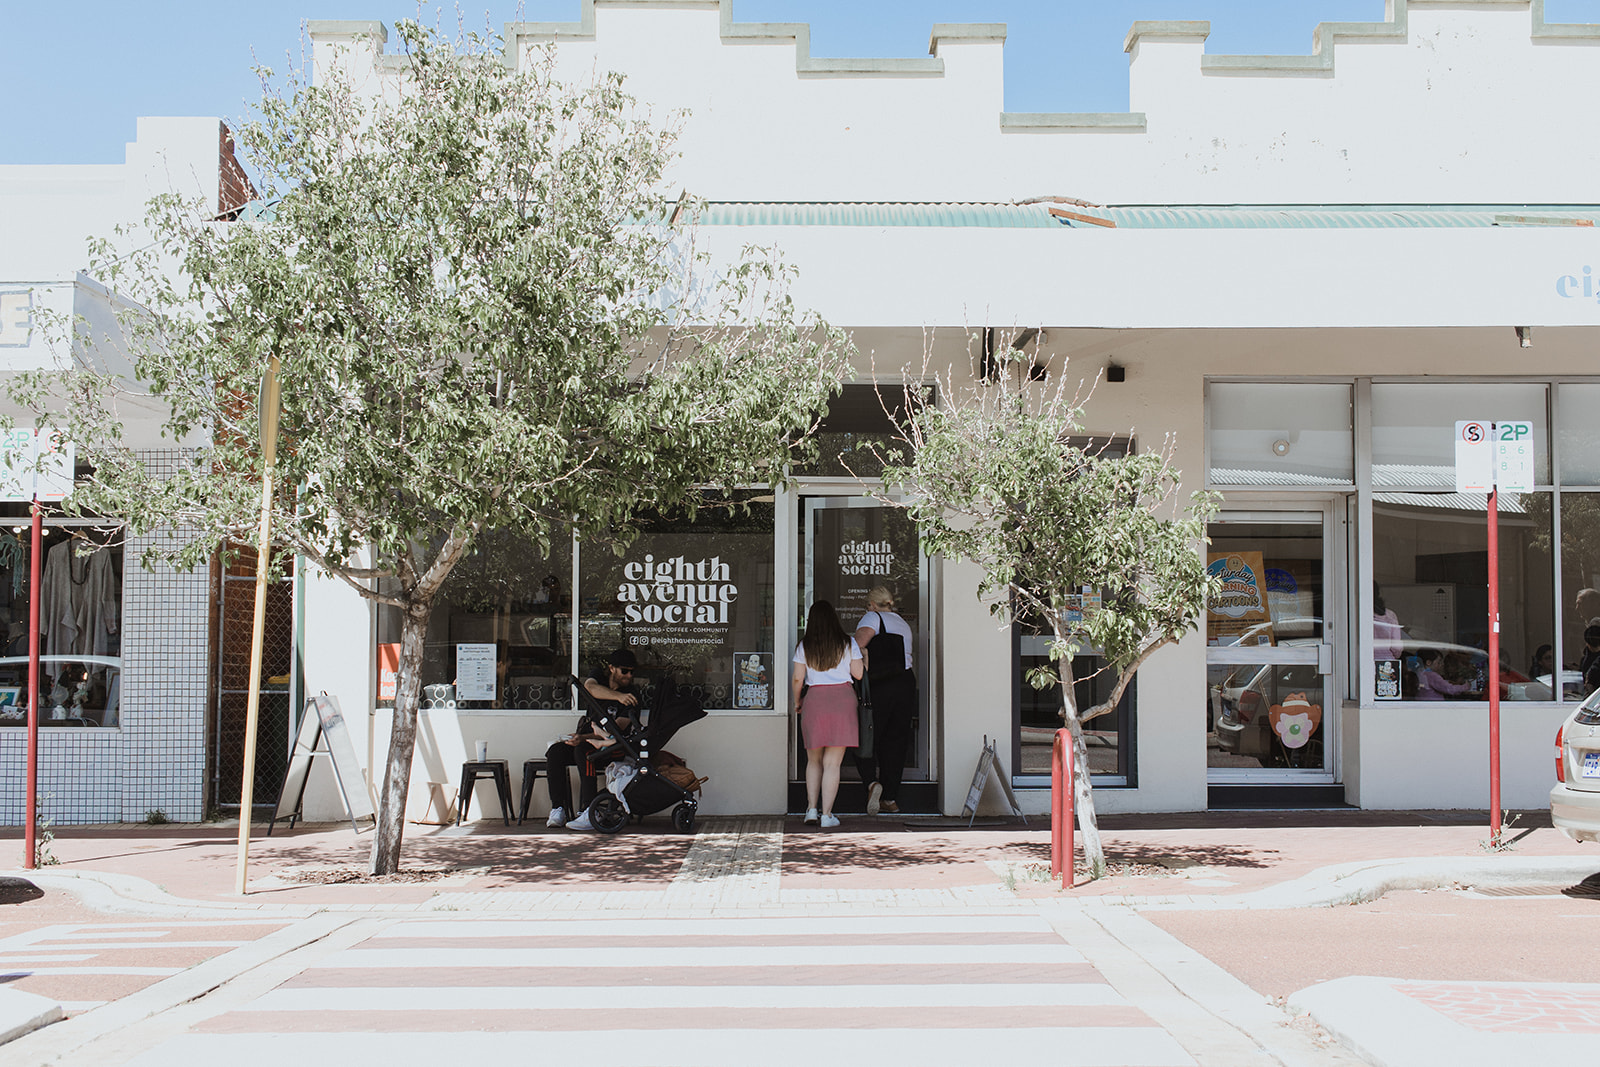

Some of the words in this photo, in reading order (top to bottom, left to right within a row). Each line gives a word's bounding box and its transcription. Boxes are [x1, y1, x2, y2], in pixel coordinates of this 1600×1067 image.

[1556, 265, 1600, 304] ei
[2, 431, 30, 448] 2P
[1501, 424, 1529, 441] 2P
[840, 540, 891, 556] eighth
[838, 553, 895, 566] avenue
[624, 554, 731, 587] eighth
[841, 563, 891, 575] social
[617, 583, 738, 607] avenue
[1207, 595, 1259, 609] CARTOONS
[624, 601, 729, 624] social
[650, 637, 724, 645] @eighthavenuesocial
[380, 668, 398, 682] Kee
